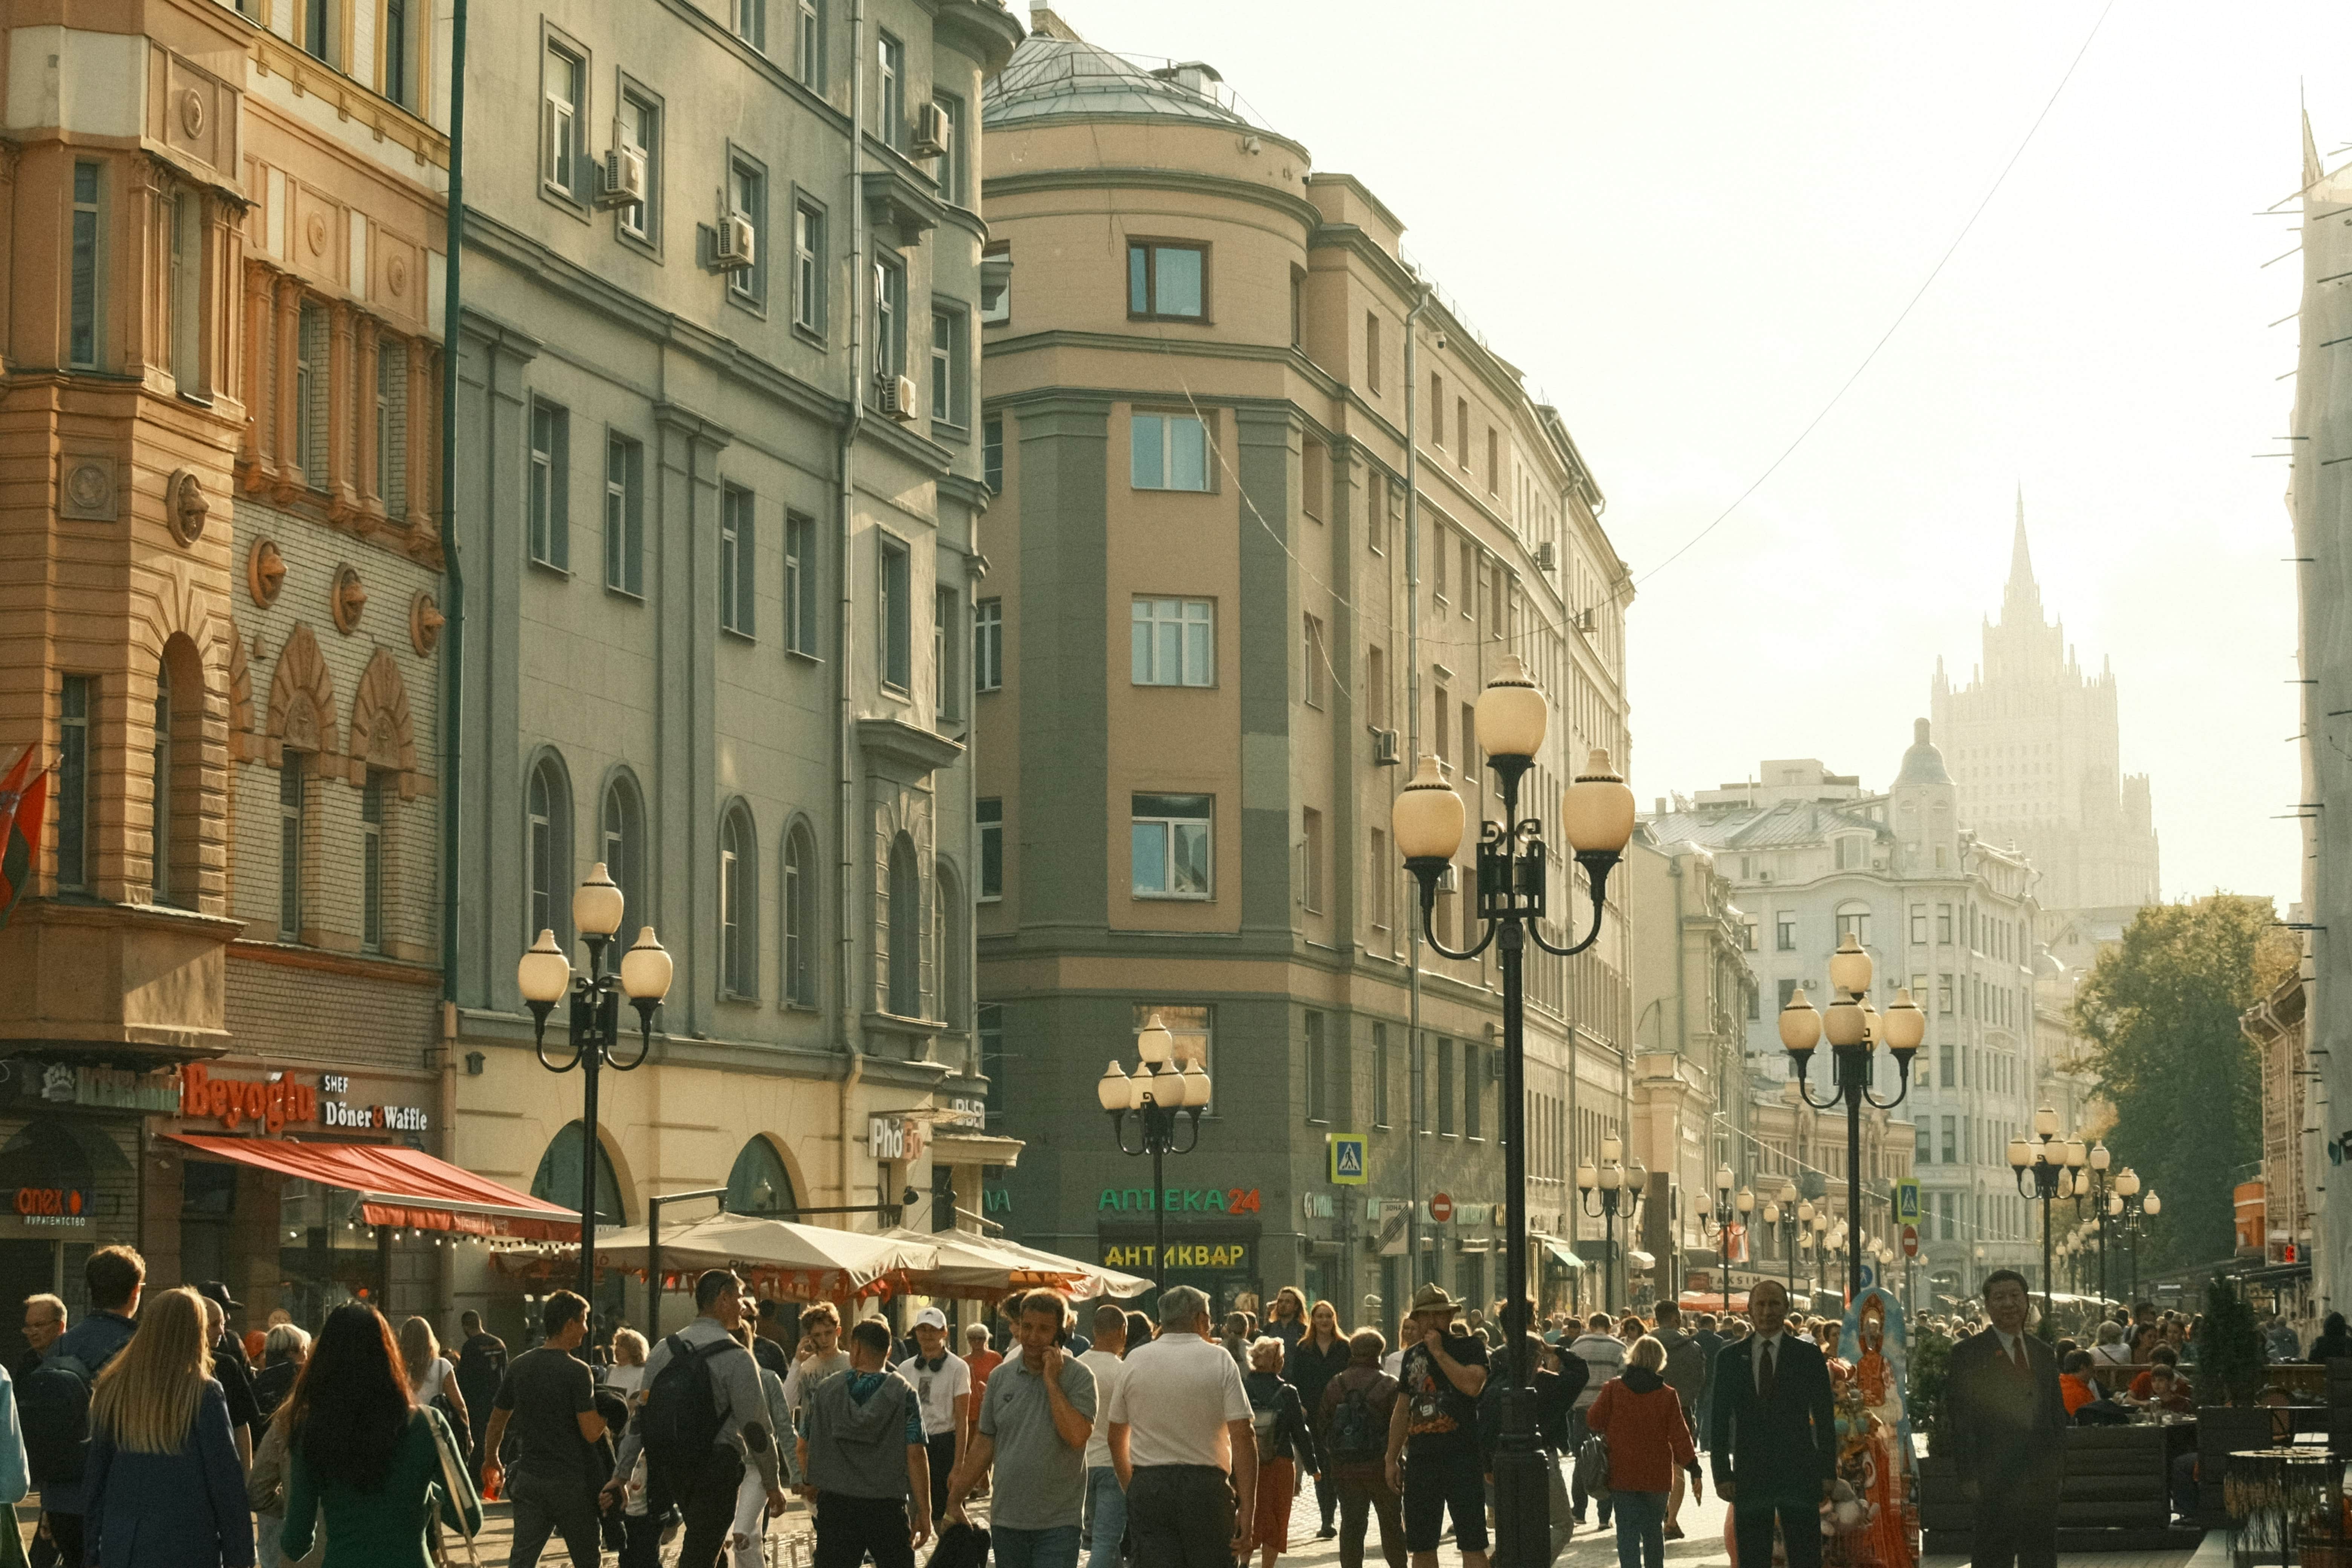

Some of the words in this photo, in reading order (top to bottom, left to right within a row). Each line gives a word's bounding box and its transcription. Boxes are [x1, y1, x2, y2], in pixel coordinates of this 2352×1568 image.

[325, 1075, 348, 1093] SHEF
[384, 1106, 427, 1130] Waffle
[1098, 1189, 1225, 1210] АПТЕКА
[1228, 1188, 1261, 1214] 24
[26, 1216, 86, 1226] ТУРАГЕНТСТВО
[1105, 1245, 1243, 1266] АНТИКВАР
[1709, 1276, 1761, 1285] TAKSIM
